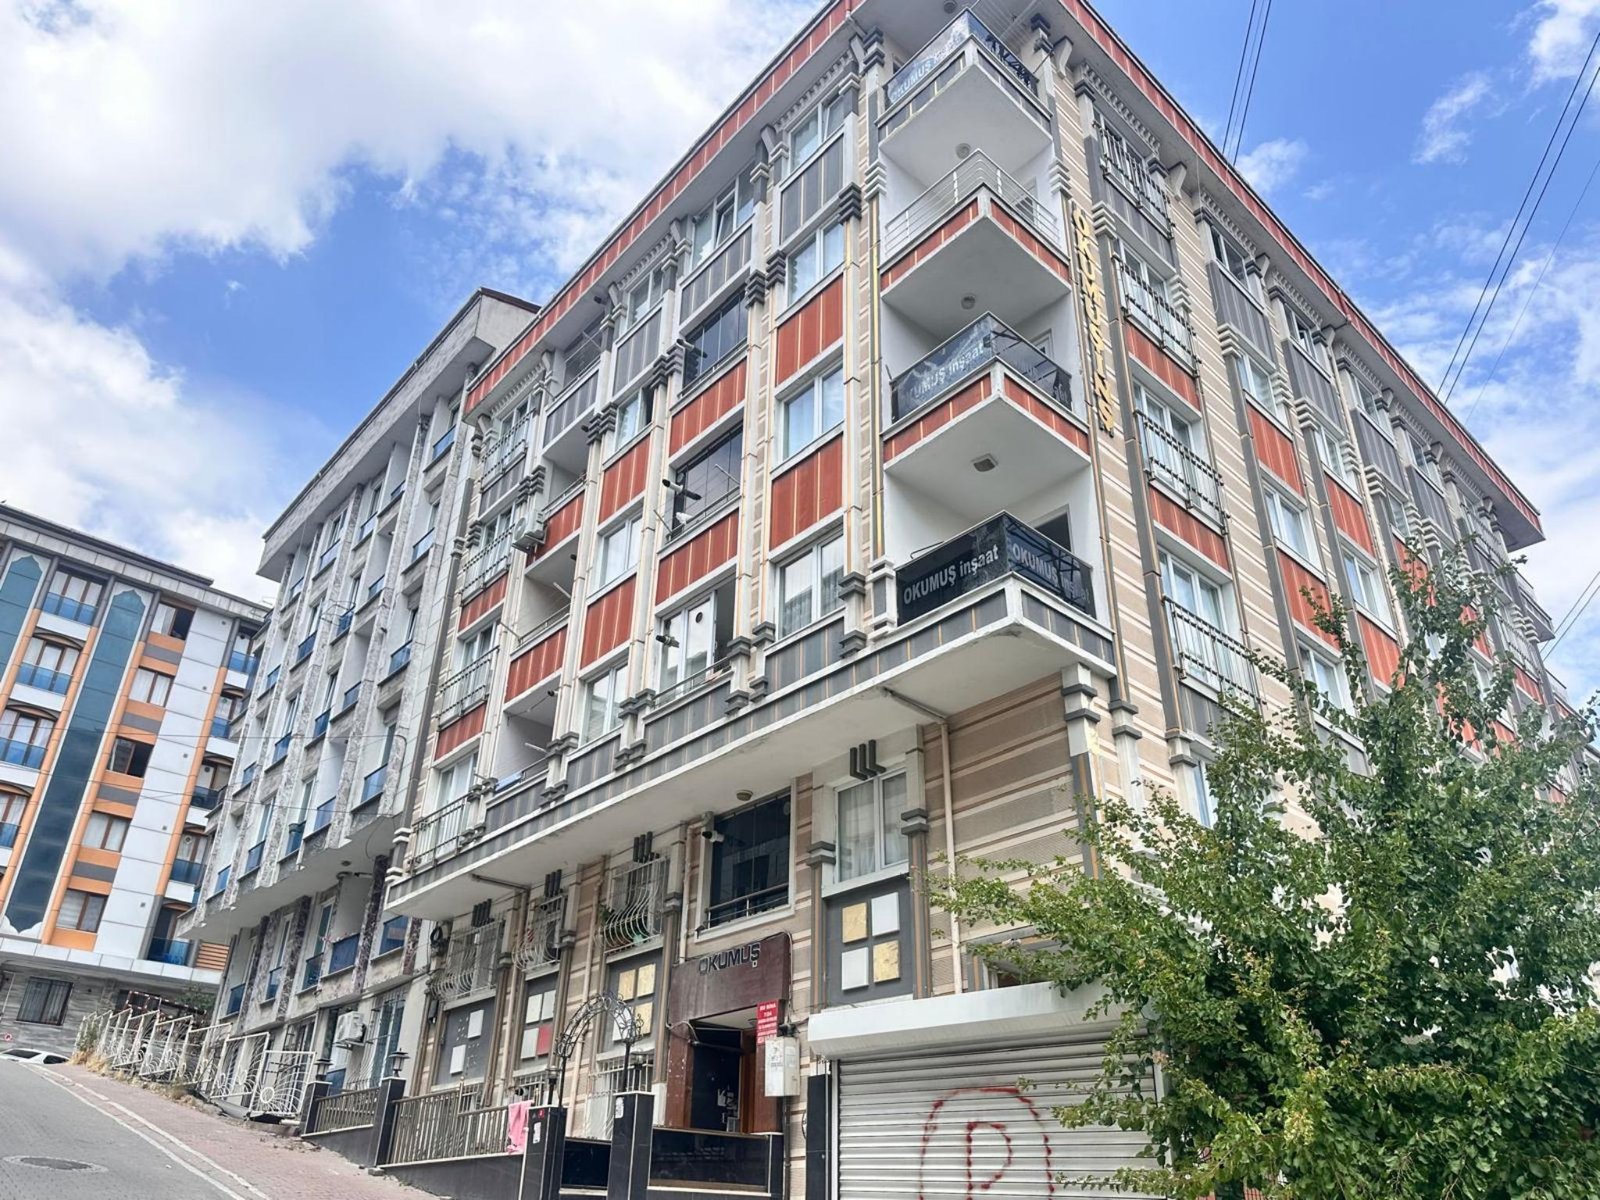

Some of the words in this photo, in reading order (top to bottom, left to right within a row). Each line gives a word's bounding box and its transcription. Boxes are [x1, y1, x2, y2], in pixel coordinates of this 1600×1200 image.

[903, 564, 957, 606] OKUMUŞ
[959, 543, 999, 577] inşaat
[1012, 543, 1059, 587] OKUMUŞ
[698, 942, 762, 976] OKUMUŞ
